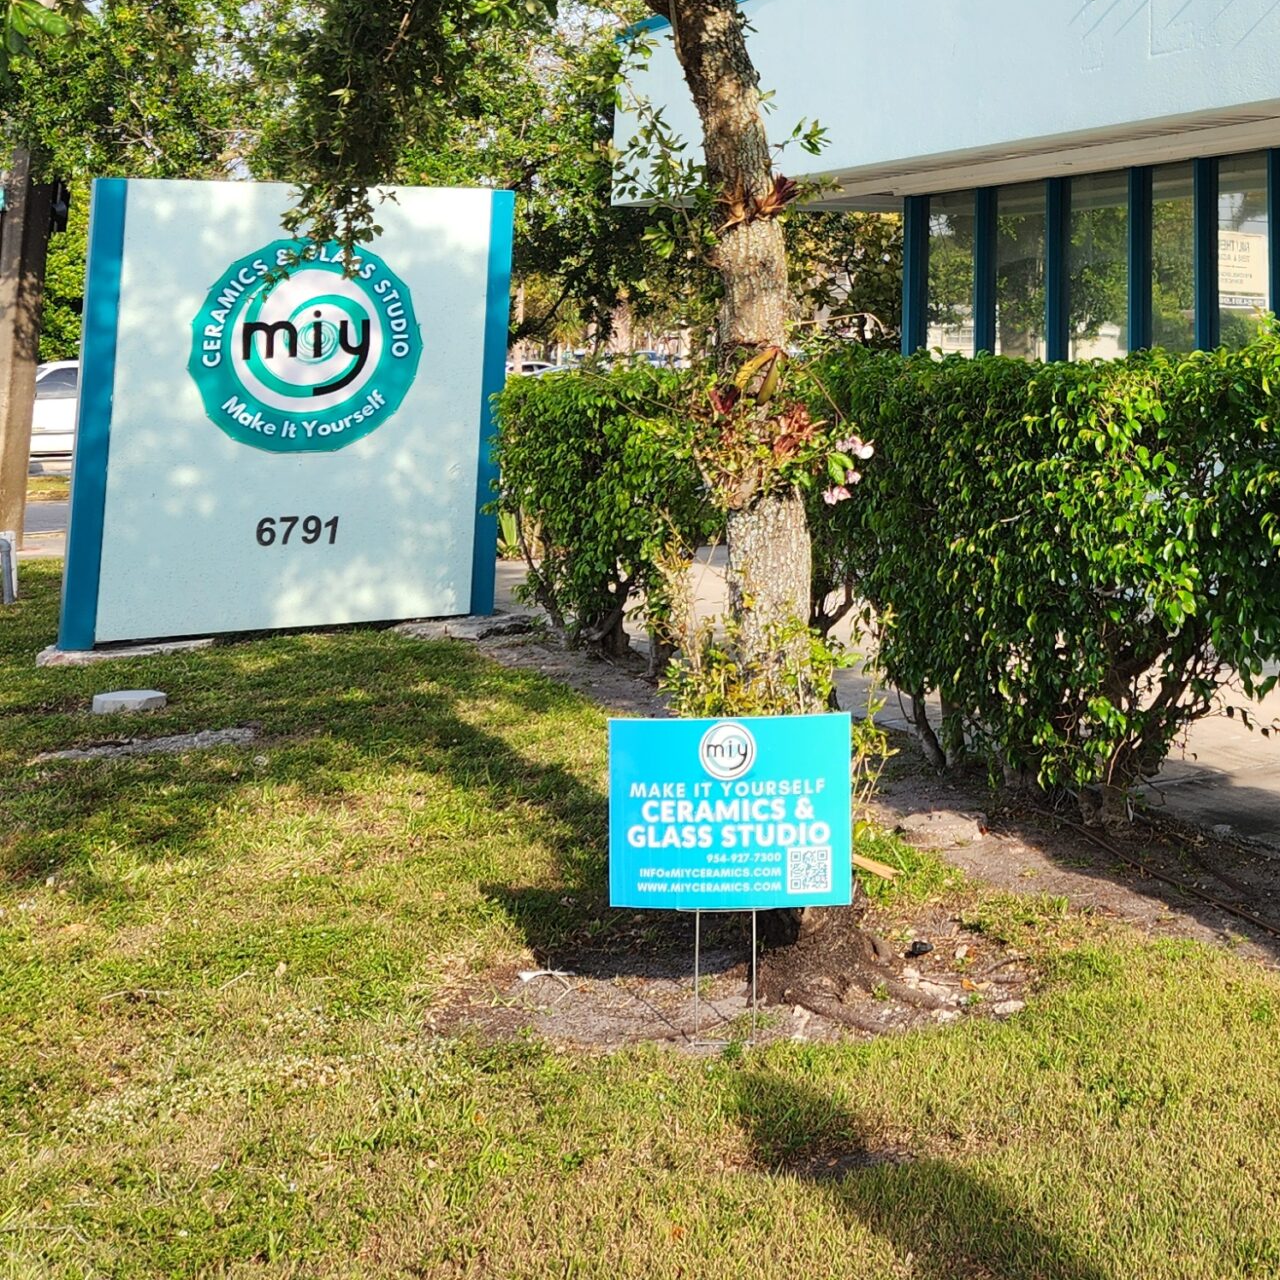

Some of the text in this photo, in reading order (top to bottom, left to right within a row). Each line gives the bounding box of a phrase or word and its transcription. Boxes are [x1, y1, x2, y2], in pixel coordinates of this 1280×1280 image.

[202, 259, 268, 367] CERAMICS
[373, 279, 409, 358] STUDIO
[242, 310, 371, 397] miy
[221, 389, 386, 438] Make It Yourself
[255, 515, 339, 546] 6791
[706, 740, 748, 770] miy
[630, 778, 826, 798] MAKE IT YOURSELF
[641, 797, 815, 823] CERAMICS &
[627, 821, 831, 848] GLASS STUDIO
[706, 852, 781, 864] 954-927-7300
[639, 867, 781, 878] INFO@MIYCERAMICS.COM
[637, 881, 781, 892] WWW.MIYCERAMICS.COM
